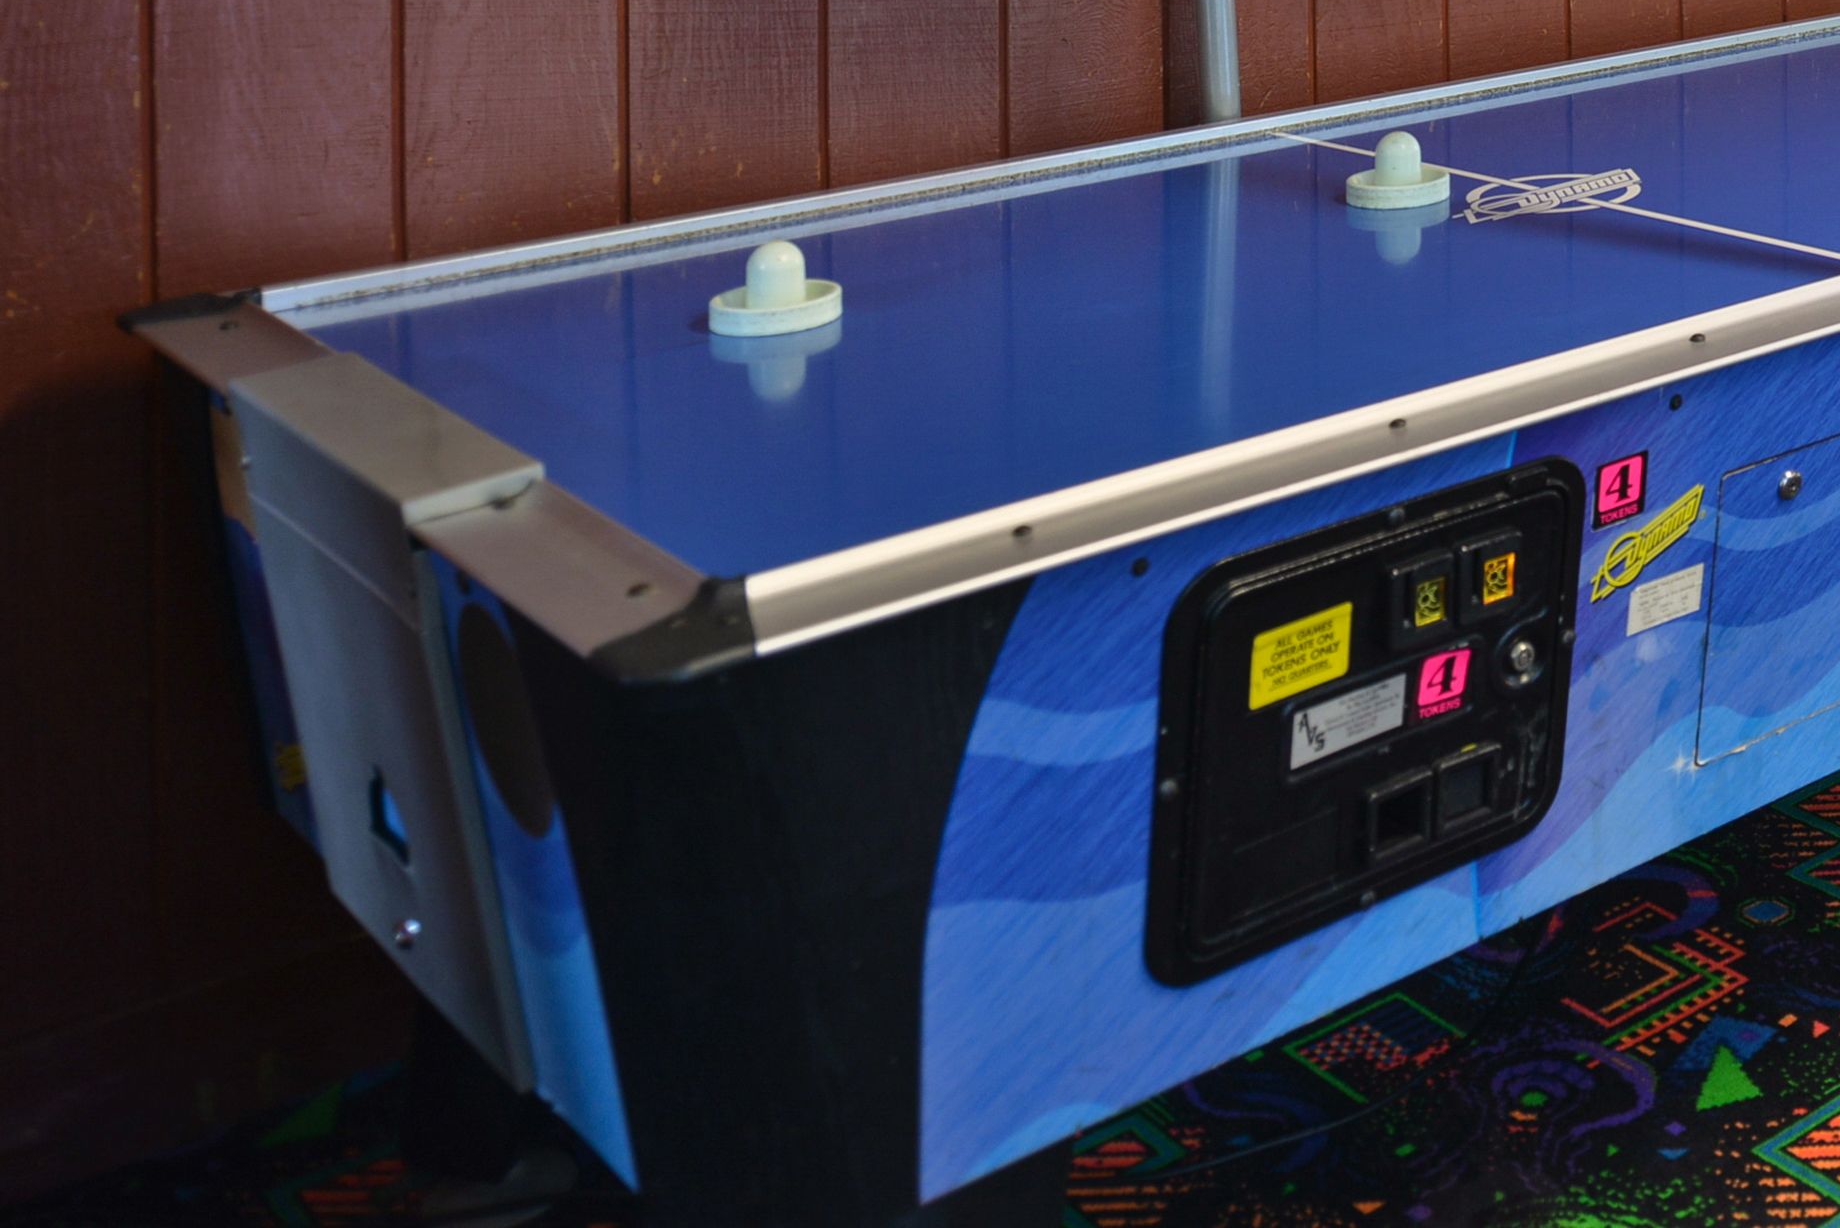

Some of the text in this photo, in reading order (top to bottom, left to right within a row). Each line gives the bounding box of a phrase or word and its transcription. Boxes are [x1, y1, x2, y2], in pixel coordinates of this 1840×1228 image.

[1605, 464, 1633, 504] 4
[1601, 504, 1638, 525] TOKENS
[1270, 633, 1334, 663] OPERATE ON
[1275, 620, 1333, 650] ALL GAMES
[1263, 641, 1340, 678] TOKENS ONLY
[1427, 656, 1457, 696] 4
[1419, 698, 1461, 719] TOKENS
